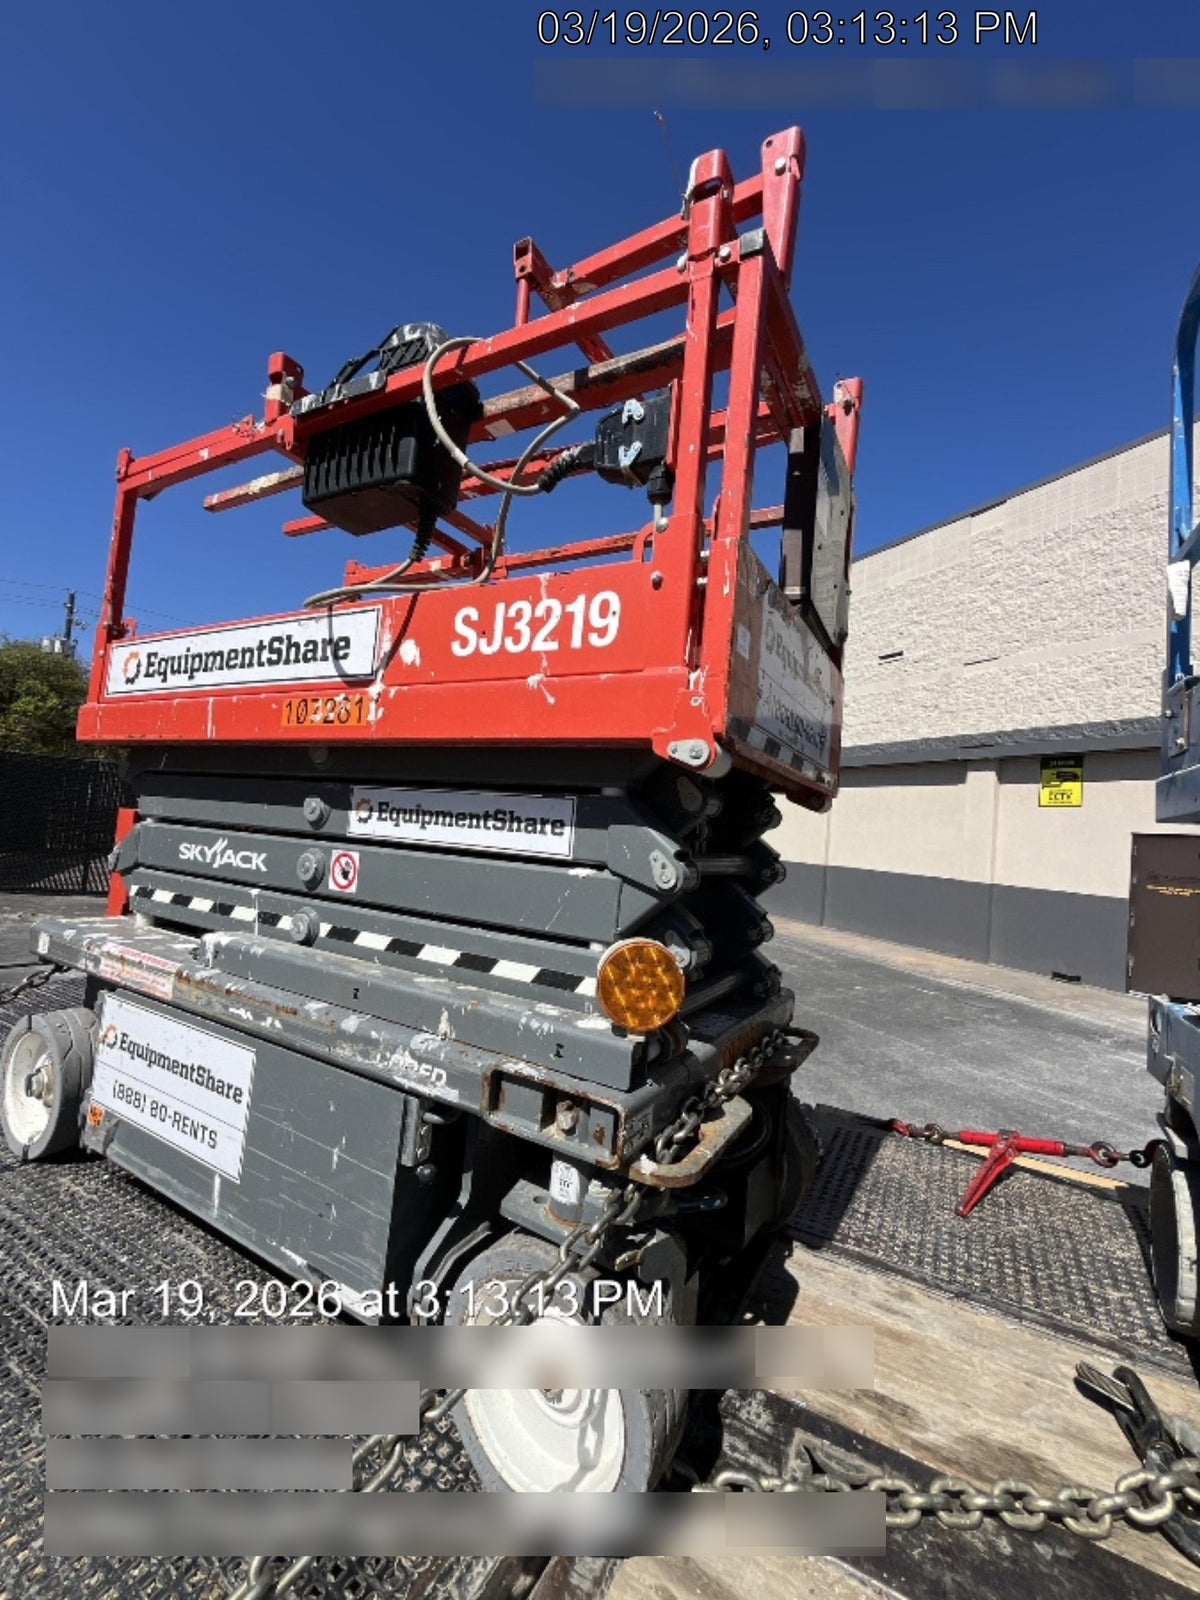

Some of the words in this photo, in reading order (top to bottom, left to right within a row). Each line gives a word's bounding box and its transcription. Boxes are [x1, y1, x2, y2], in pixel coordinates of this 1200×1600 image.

[451, 590, 621, 657] SJ3219
[143, 634, 351, 684] EquipmentShare
[376, 801, 566, 836] EquipmentShare
[179, 837, 268, 872] SKYJACK
[120, 1032, 243, 1104] EquipmentShare
[150, 1099, 218, 1149] 80-RENTS
